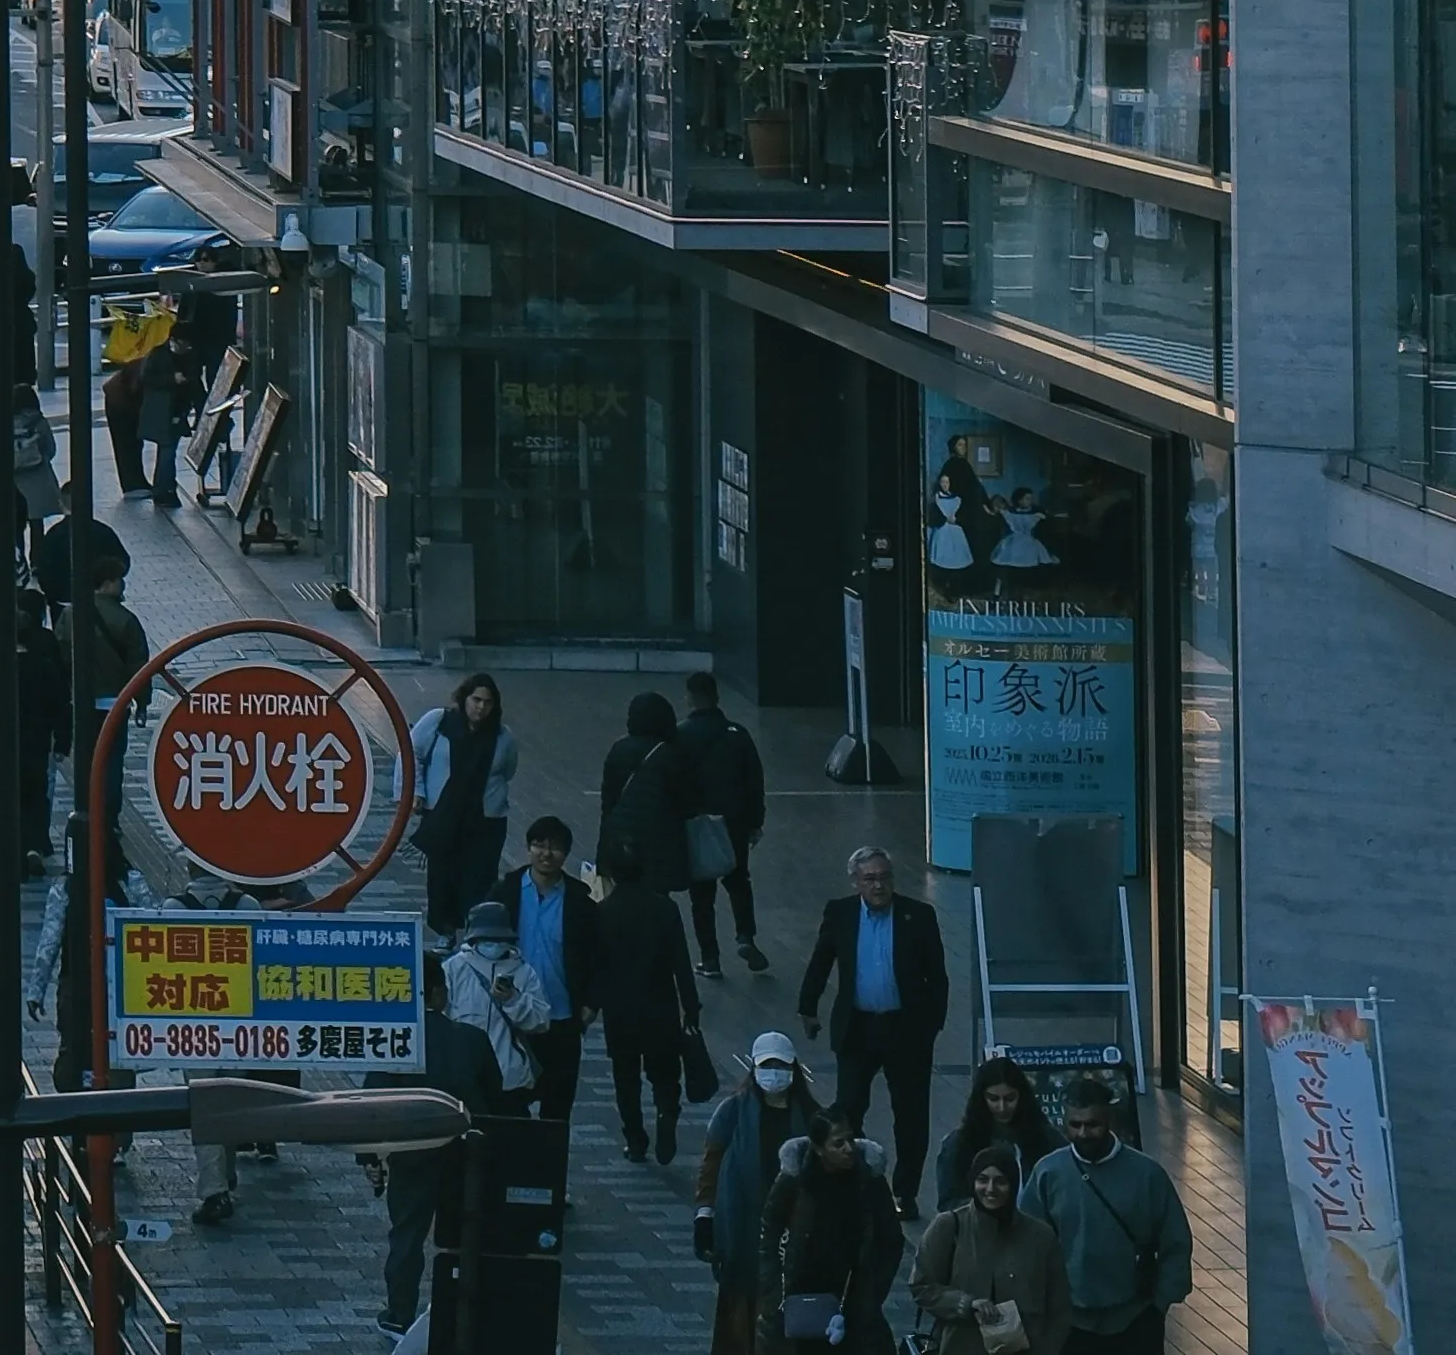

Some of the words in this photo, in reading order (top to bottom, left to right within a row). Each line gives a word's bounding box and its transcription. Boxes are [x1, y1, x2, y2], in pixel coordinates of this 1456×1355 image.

[959, 598, 1086, 618] INTERIEURS
[944, 640, 1108, 662] オルセー美術館所蔵
[189, 692, 232, 716] FIRE
[239, 693, 330, 718] HYDRANT
[943, 659, 1109, 718] 印象派
[945, 710, 1109, 742] 室内をめぐる物語
[174, 730, 352, 813] 消火栓
[127, 925, 249, 965] 中国語
[256, 928, 412, 948] 肝臓・糖尿病専門外来
[146, 974, 231, 1012] 対応
[257, 965, 413, 1003] 協和医院
[125, 1024, 290, 1059] 03-3835-0186
[296, 1025, 413, 1059] 多慶屋そば
